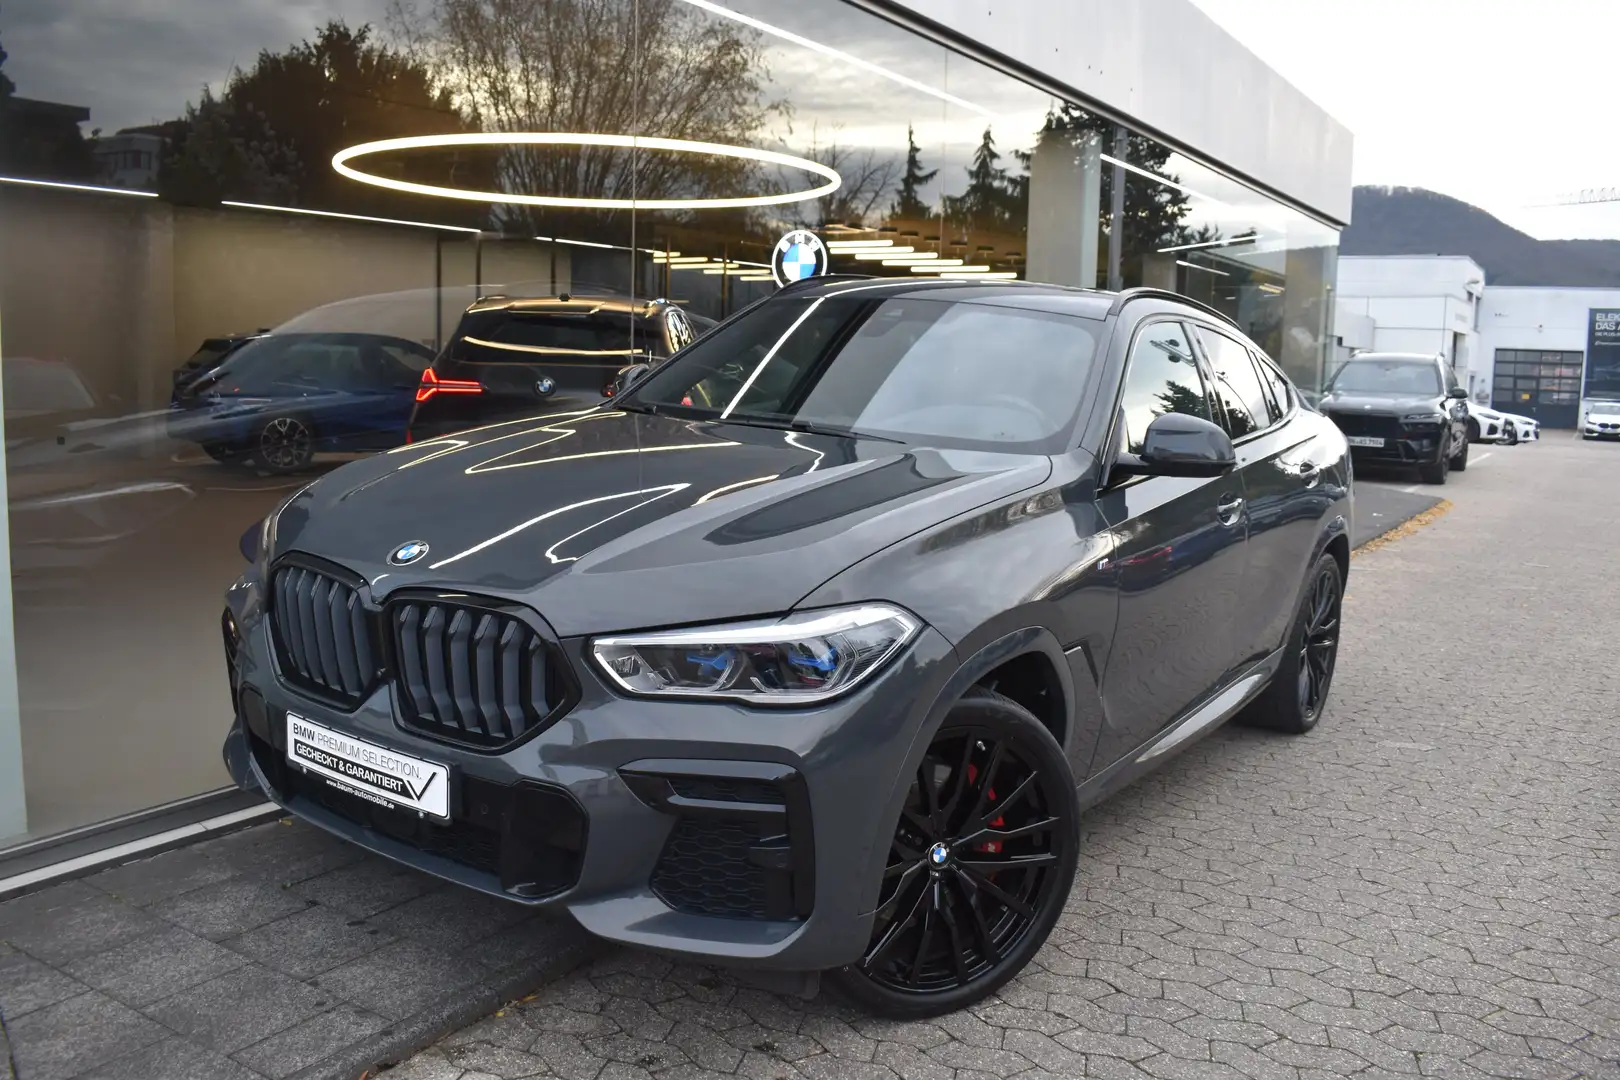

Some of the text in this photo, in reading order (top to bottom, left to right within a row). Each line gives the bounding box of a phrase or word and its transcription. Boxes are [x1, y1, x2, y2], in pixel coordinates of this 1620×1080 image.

[293, 722, 422, 780] BMW PREMIUM SELECTION.
[296, 743, 403, 792] GECHECKT & GARANTIERT
[326, 779, 395, 809] www.baum-automobile.de
